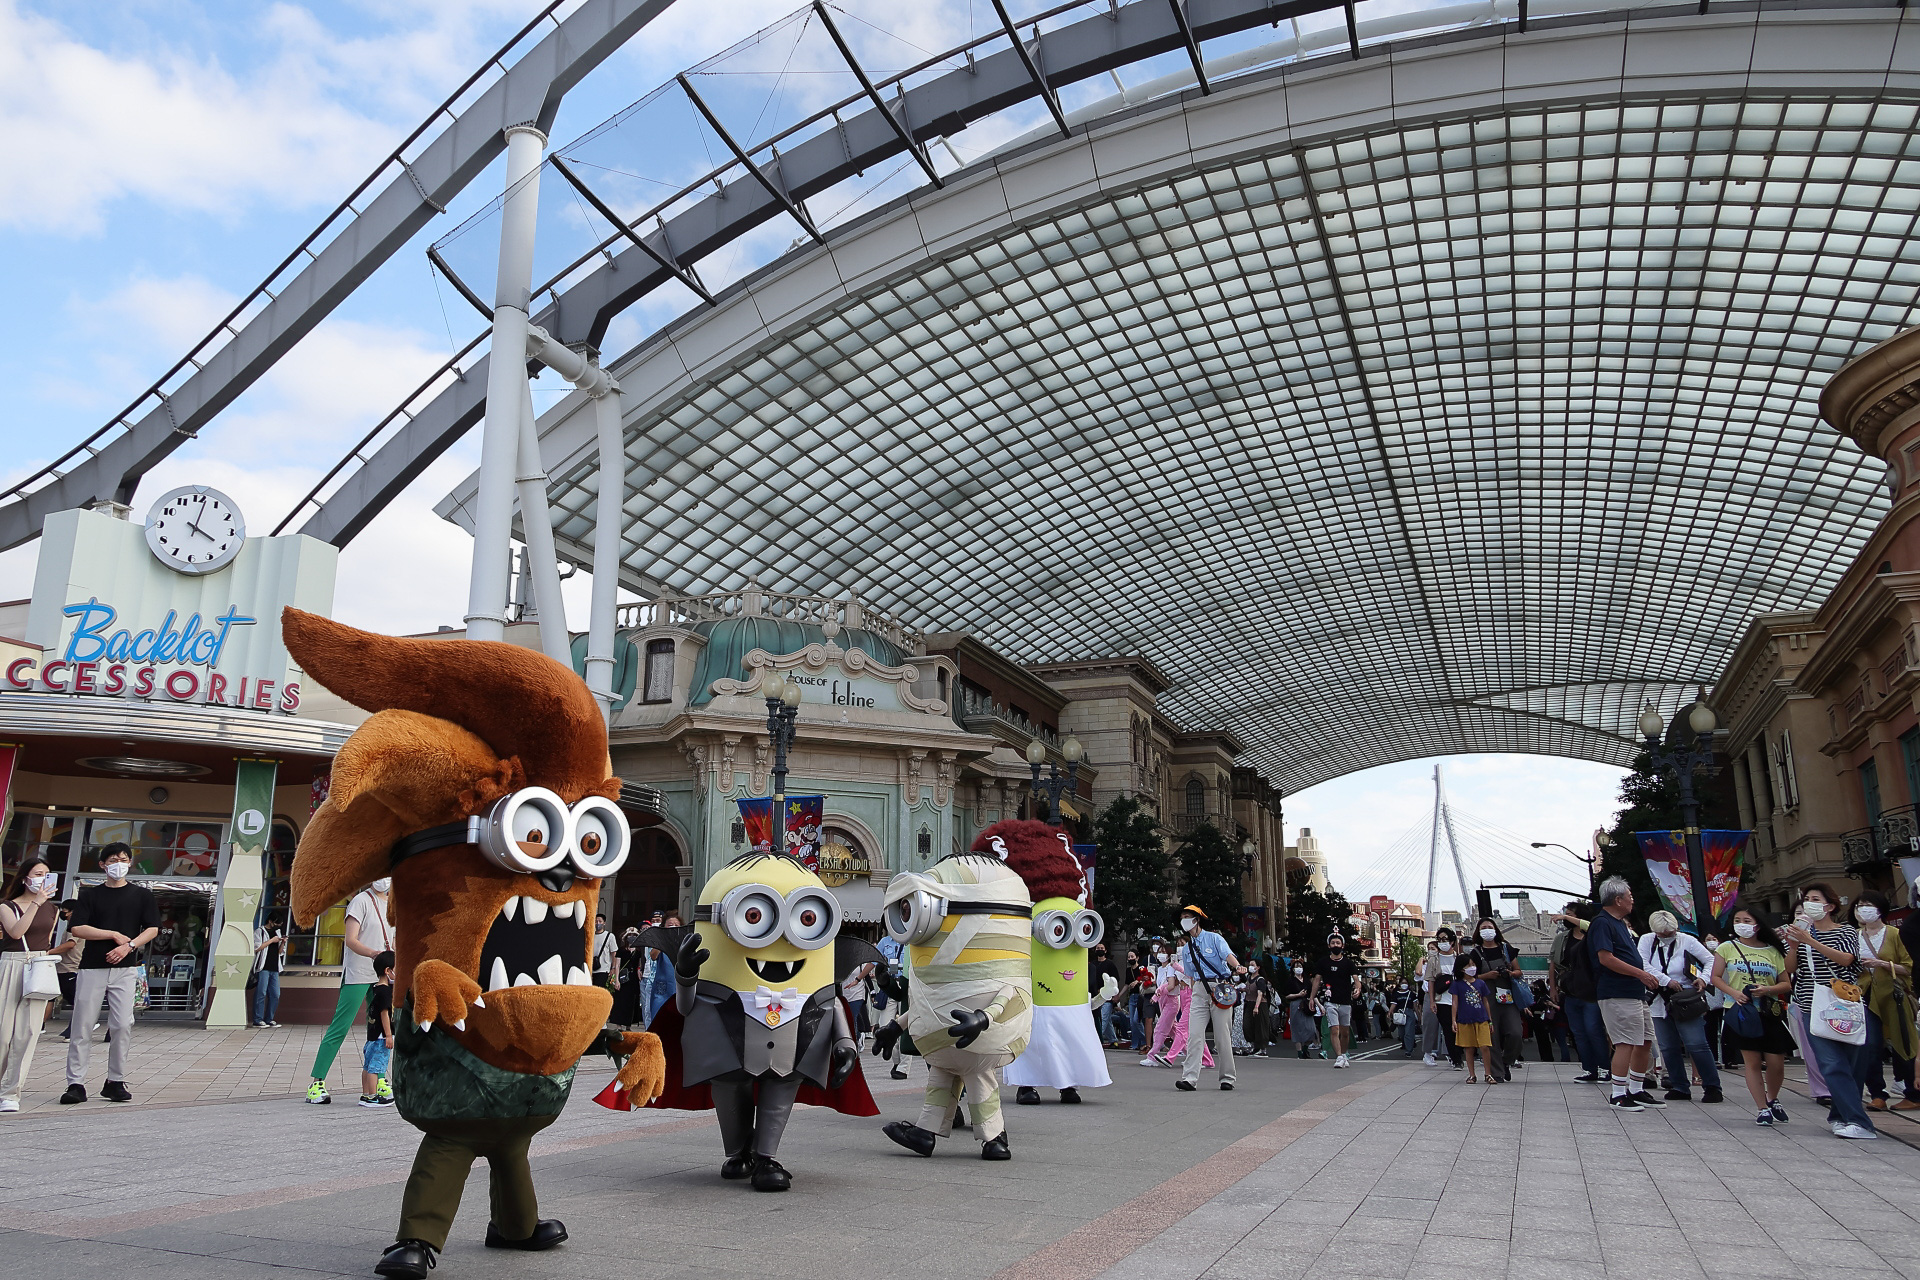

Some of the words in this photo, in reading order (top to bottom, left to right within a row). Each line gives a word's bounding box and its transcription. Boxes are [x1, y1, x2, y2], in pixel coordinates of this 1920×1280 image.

[177, 498, 188, 506] 11
[163, 508, 176, 516] 10
[223, 513, 231, 521] 2
[156, 520, 164, 528] 9
[226, 528, 234, 536] 3
[159, 536, 167, 544] 8
[171, 547, 179, 556] 7
[205, 552, 213, 560] 5
[62, 597, 257, 667] Backlot
[794, 675, 815, 685] OUSE
[817, 678, 827, 686] OF
[831, 680, 875, 708] feline
[244, 813, 257, 830] L
[845, 859, 871, 871] STUDIOS
[1381, 911, 1389, 957] STORE
